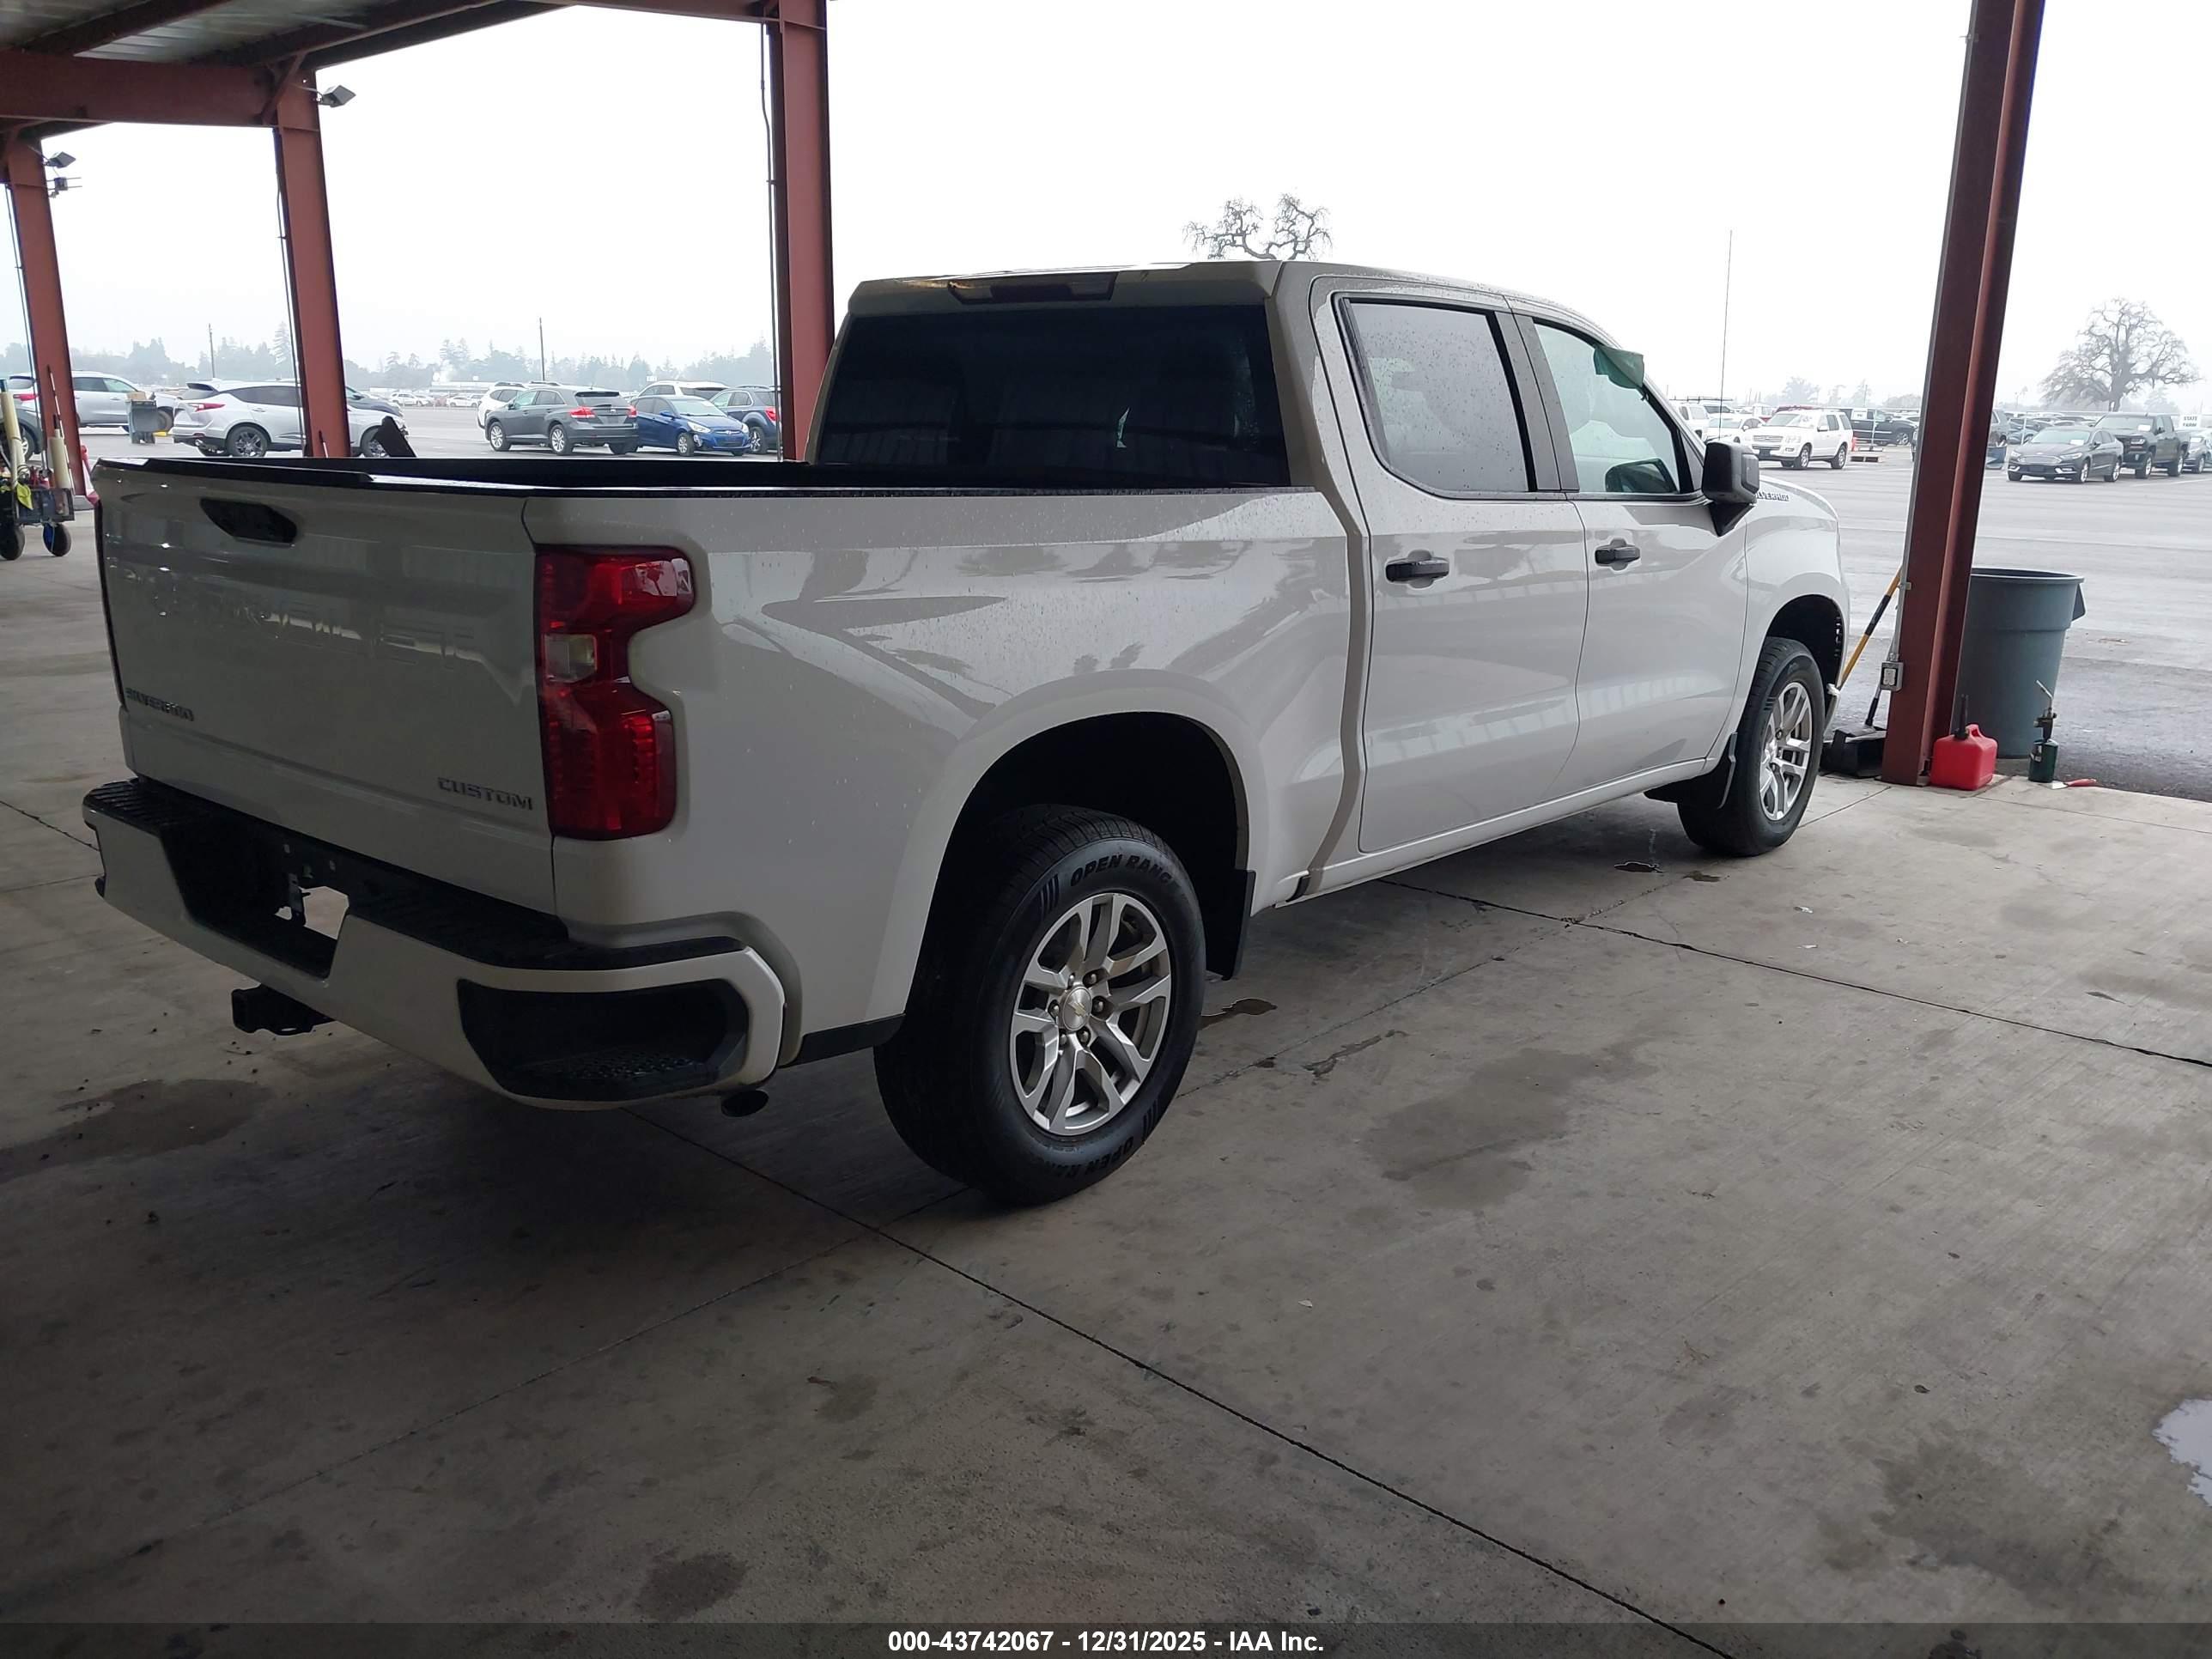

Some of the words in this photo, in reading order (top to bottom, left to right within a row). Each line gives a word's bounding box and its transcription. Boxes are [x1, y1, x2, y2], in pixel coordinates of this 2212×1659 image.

[437, 776, 533, 811] CUSTOM
[1070, 854, 1123, 886] OPEN
[1126, 854, 1173, 884] RANG
